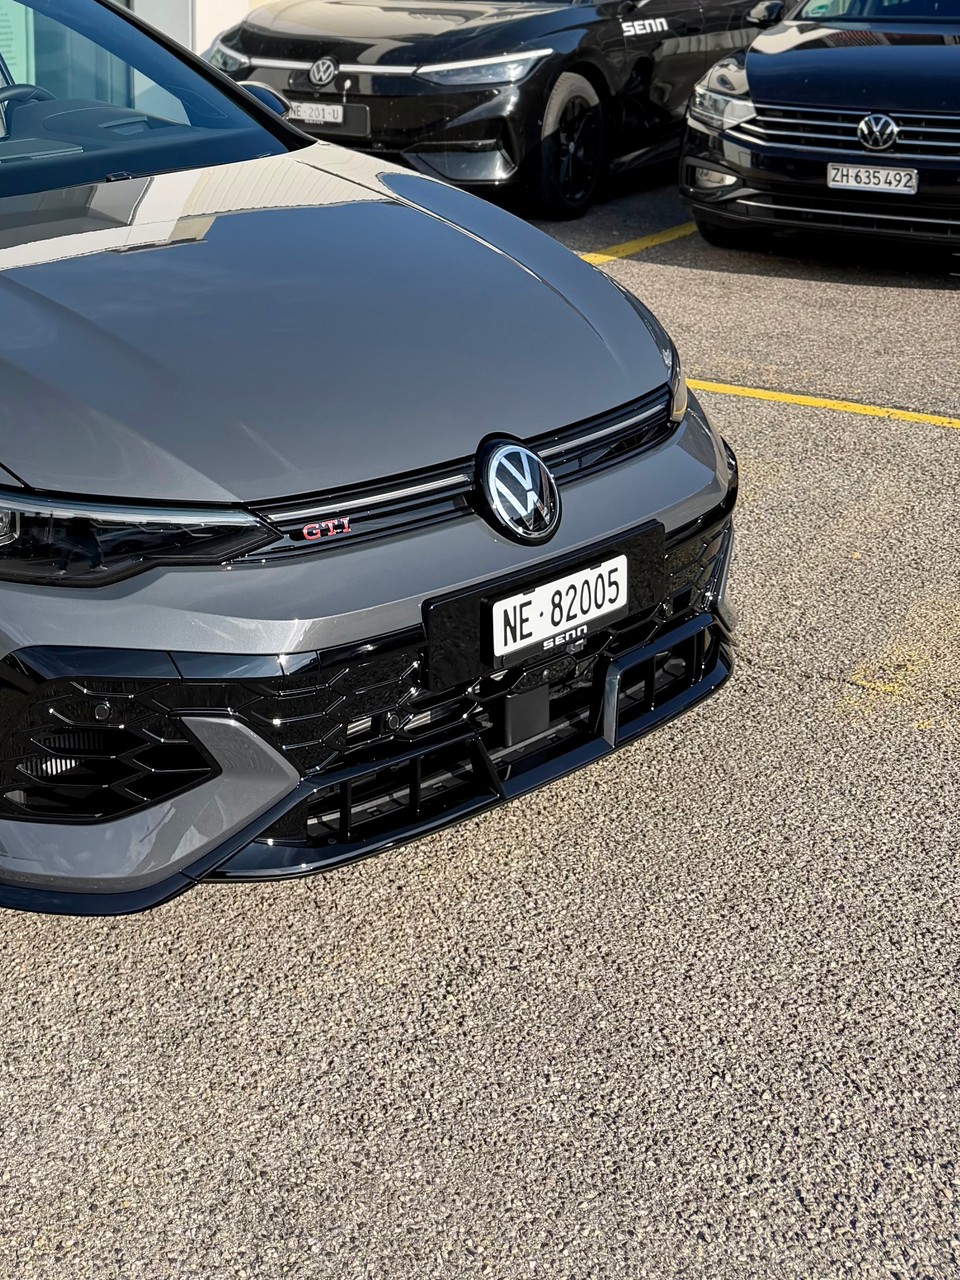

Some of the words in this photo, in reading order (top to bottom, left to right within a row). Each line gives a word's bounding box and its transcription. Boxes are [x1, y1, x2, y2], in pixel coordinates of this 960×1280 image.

[621, 18, 669, 37] SENN
[302, 516, 352, 541] GTI
[543, 624, 588, 650] SENN
